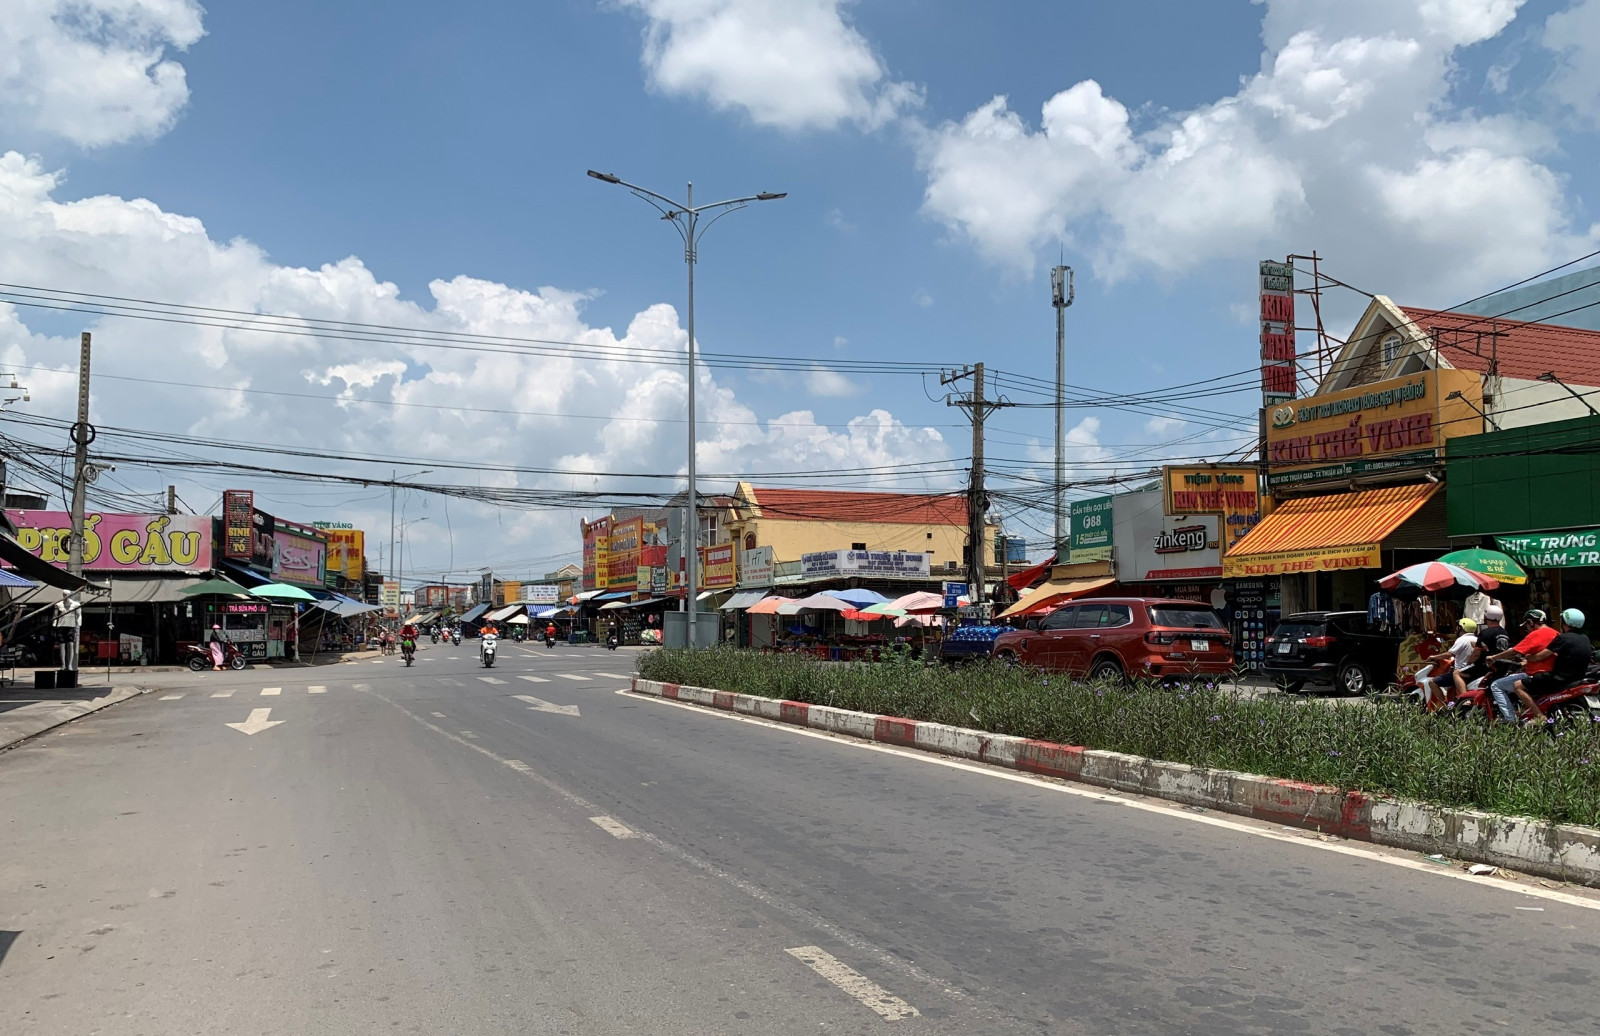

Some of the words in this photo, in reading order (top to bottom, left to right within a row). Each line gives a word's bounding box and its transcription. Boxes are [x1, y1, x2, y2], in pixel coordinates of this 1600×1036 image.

[1263, 295, 1294, 322] KIM
[1264, 366, 1297, 393] VINH
[1270, 435, 1312, 463] KIM
[1315, 414, 1363, 459] THẾ
[1365, 413, 1434, 452] VINH
[1184, 473, 1211, 486] TIỆM
[1215, 473, 1244, 484] VÀNG
[1174, 491, 1199, 508] KIM
[1200, 485, 1225, 508] THẾ
[1225, 491, 1256, 508] VINH
[228, 528, 250, 536] SINH
[332, 521, 353, 529] VÀNG
[110, 516, 201, 566] GẤU
[1154, 529, 1205, 549] zinkeng
[1498, 539, 1530, 553] THỊT
[1540, 534, 1596, 549] TRỨNG
[1244, 563, 1275, 574] KIM
[1281, 556, 1318, 571] THẾ
[1321, 555, 1371, 568] VINH
[1531, 549, 1567, 566] NẤM
